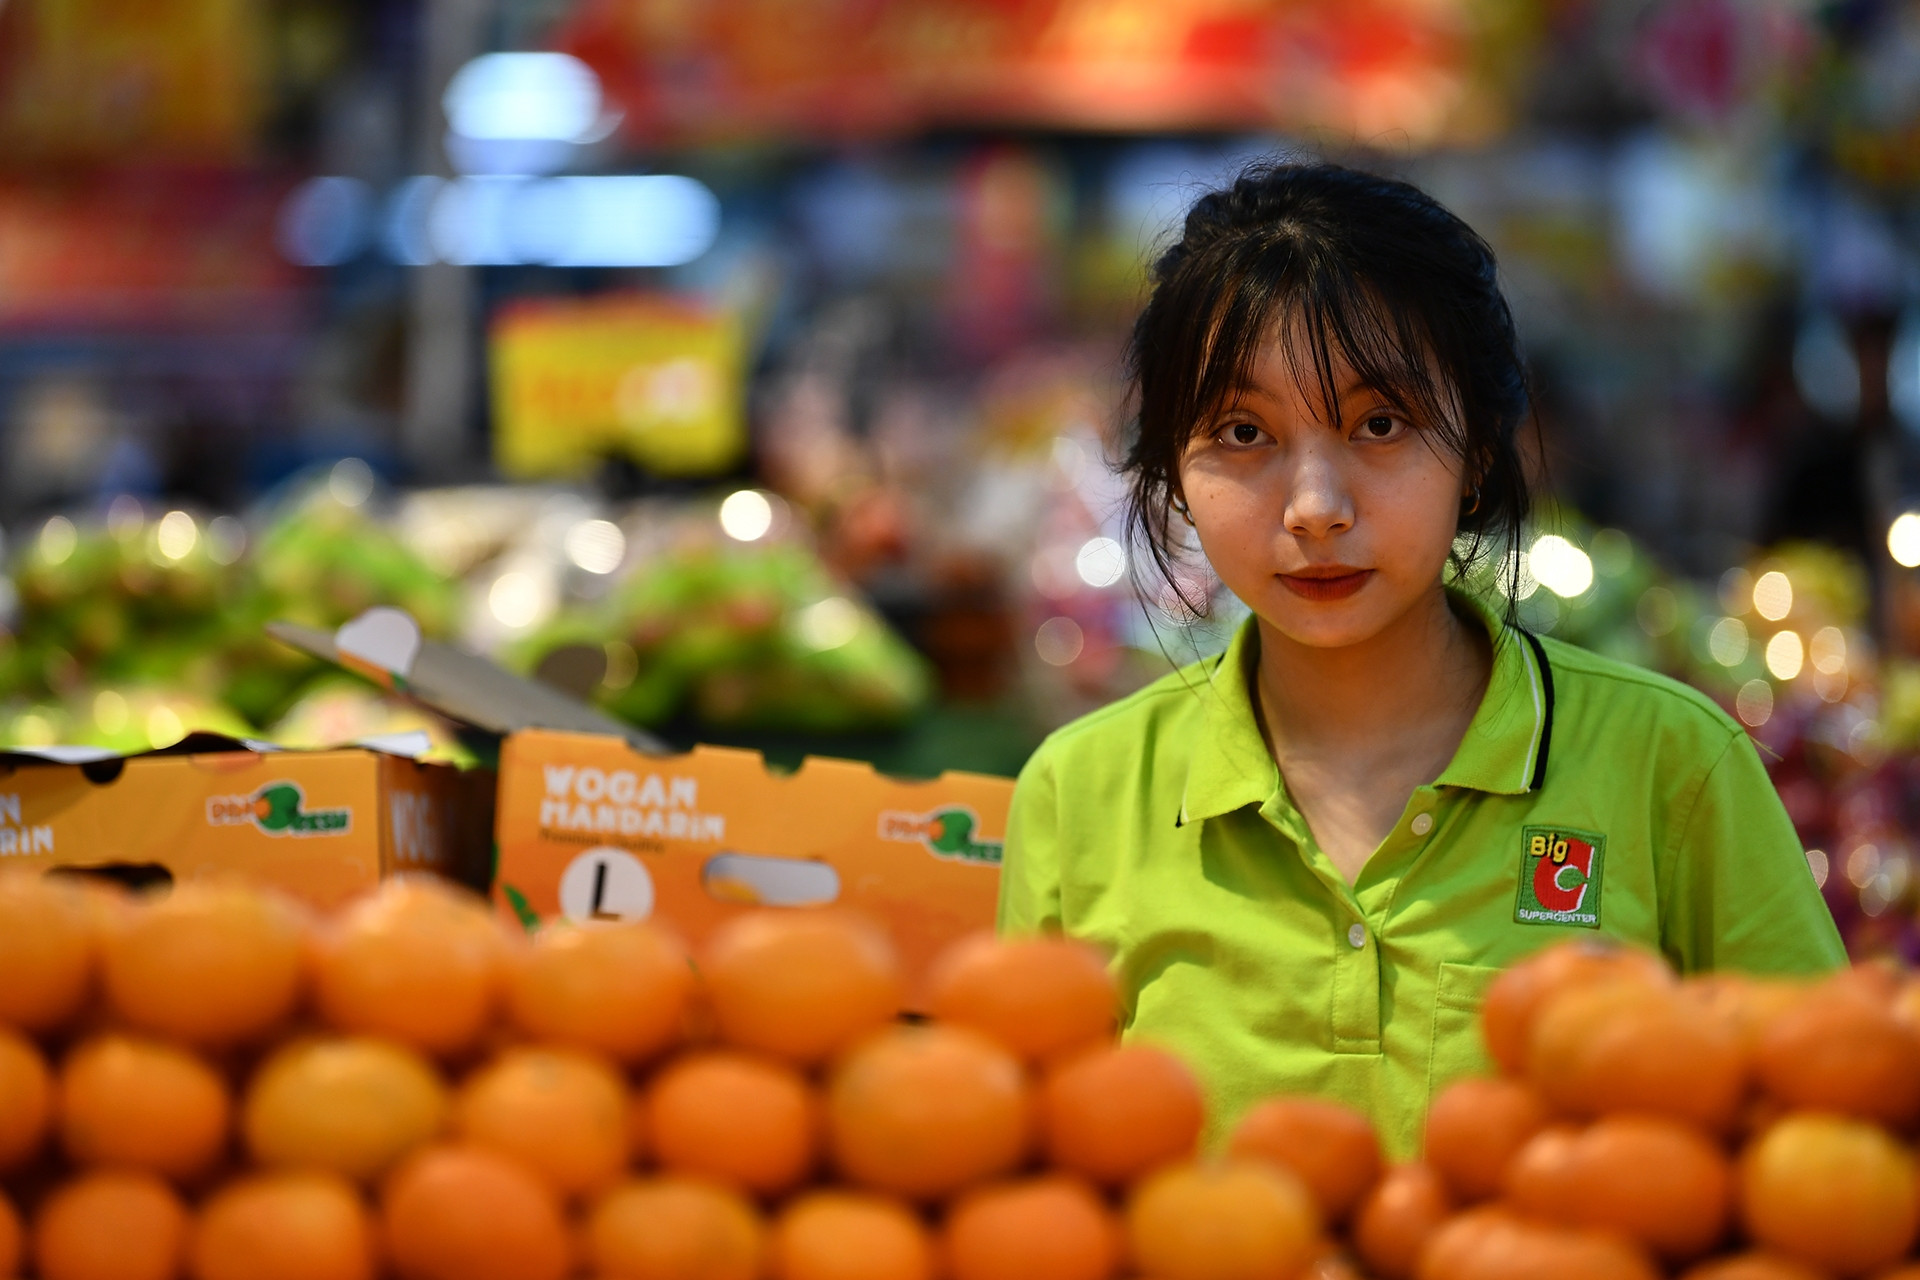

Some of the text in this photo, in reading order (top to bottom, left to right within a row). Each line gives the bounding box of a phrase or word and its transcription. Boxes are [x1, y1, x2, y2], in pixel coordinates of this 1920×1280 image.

[545, 766, 697, 808] WOGAN
[589, 861, 622, 921] L
[1530, 833, 1595, 913] Big C
[1520, 909, 1597, 923] SUPERCENTER
